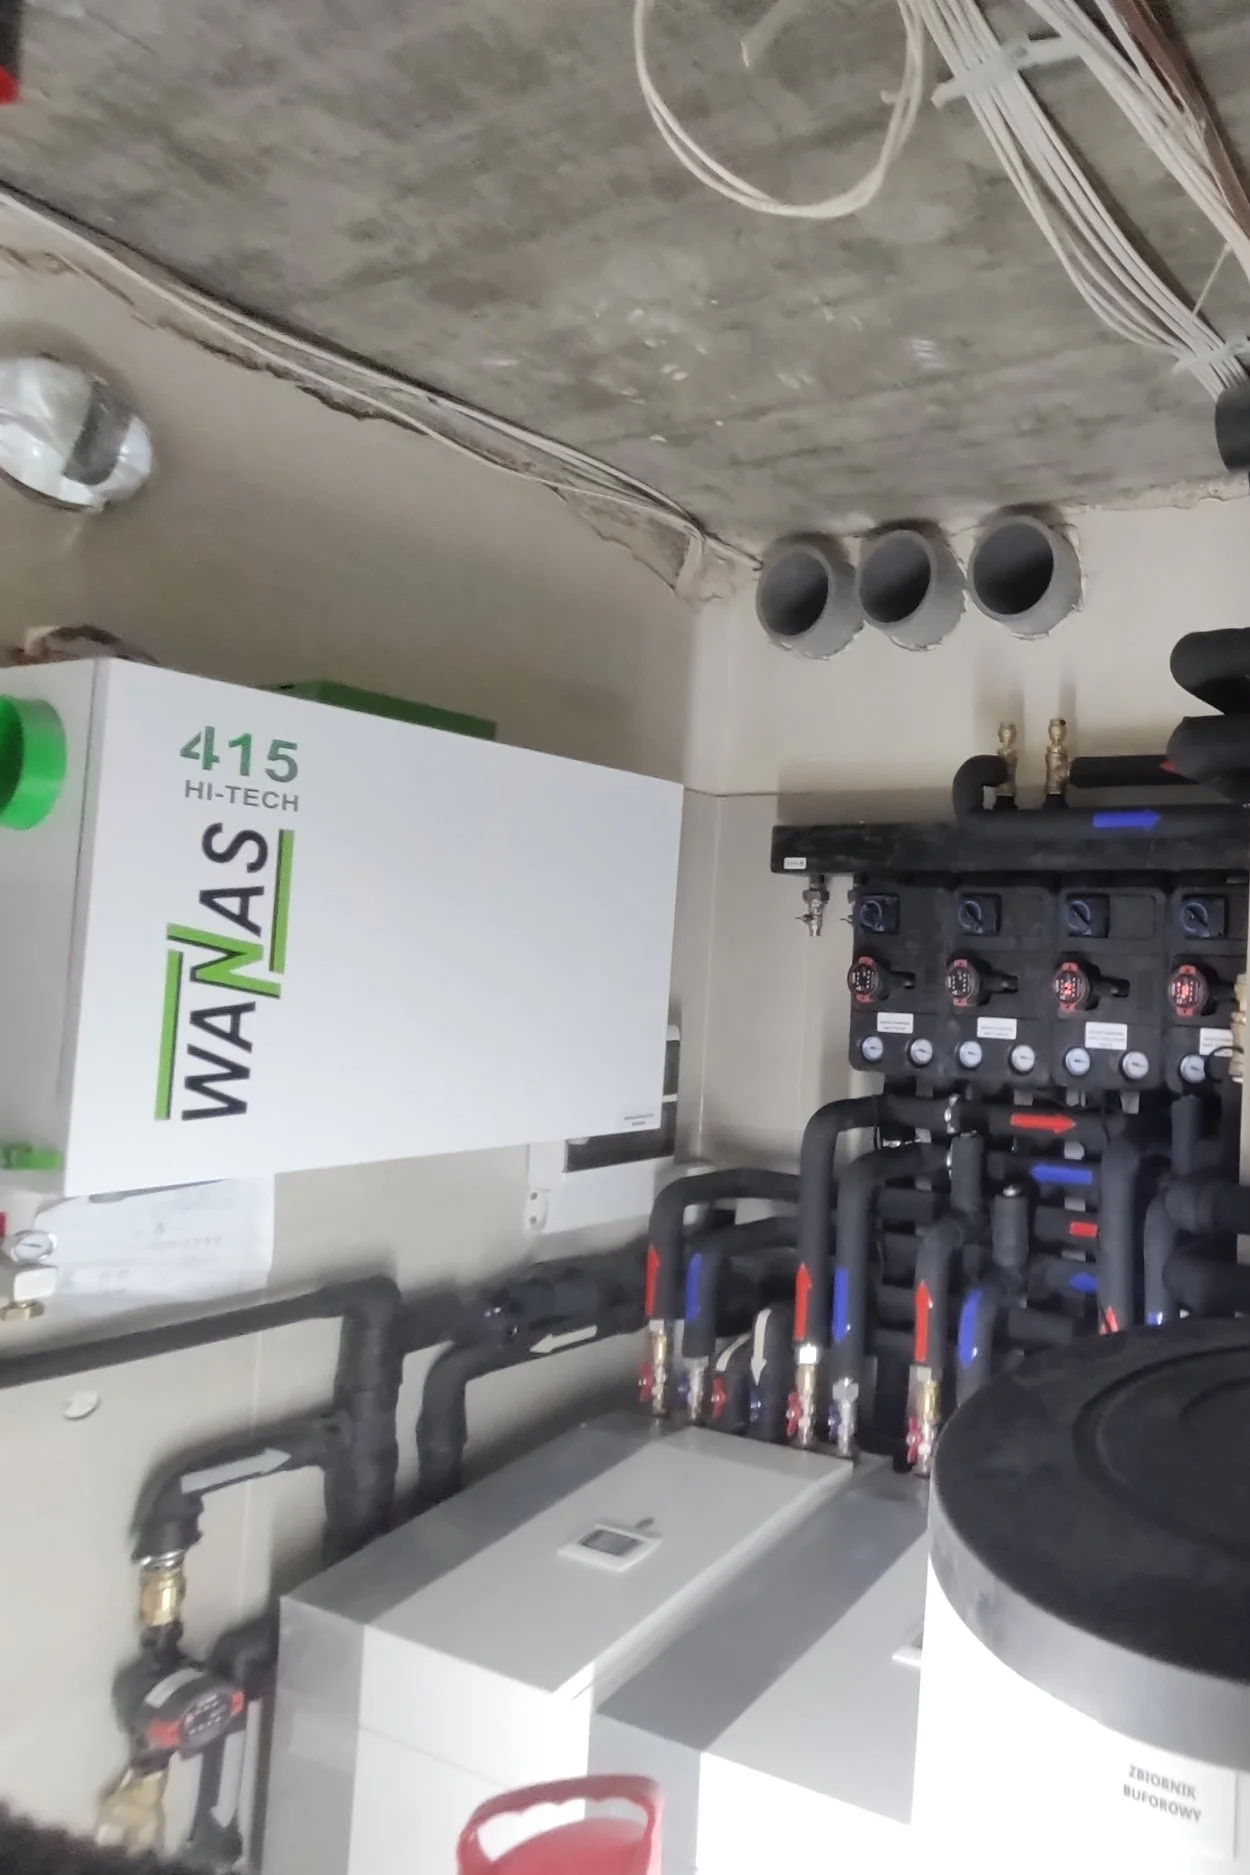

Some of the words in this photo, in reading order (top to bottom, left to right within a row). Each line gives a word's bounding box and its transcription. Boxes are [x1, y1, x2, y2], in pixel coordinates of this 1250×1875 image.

[179, 725, 299, 784] 415
[184, 779, 300, 813] HI-TECH
[166, 822, 282, 1121] WANAS
[1129, 1763, 1197, 1801] ZBIORNIK
[1123, 1783, 1202, 1823] BUFOROWY
